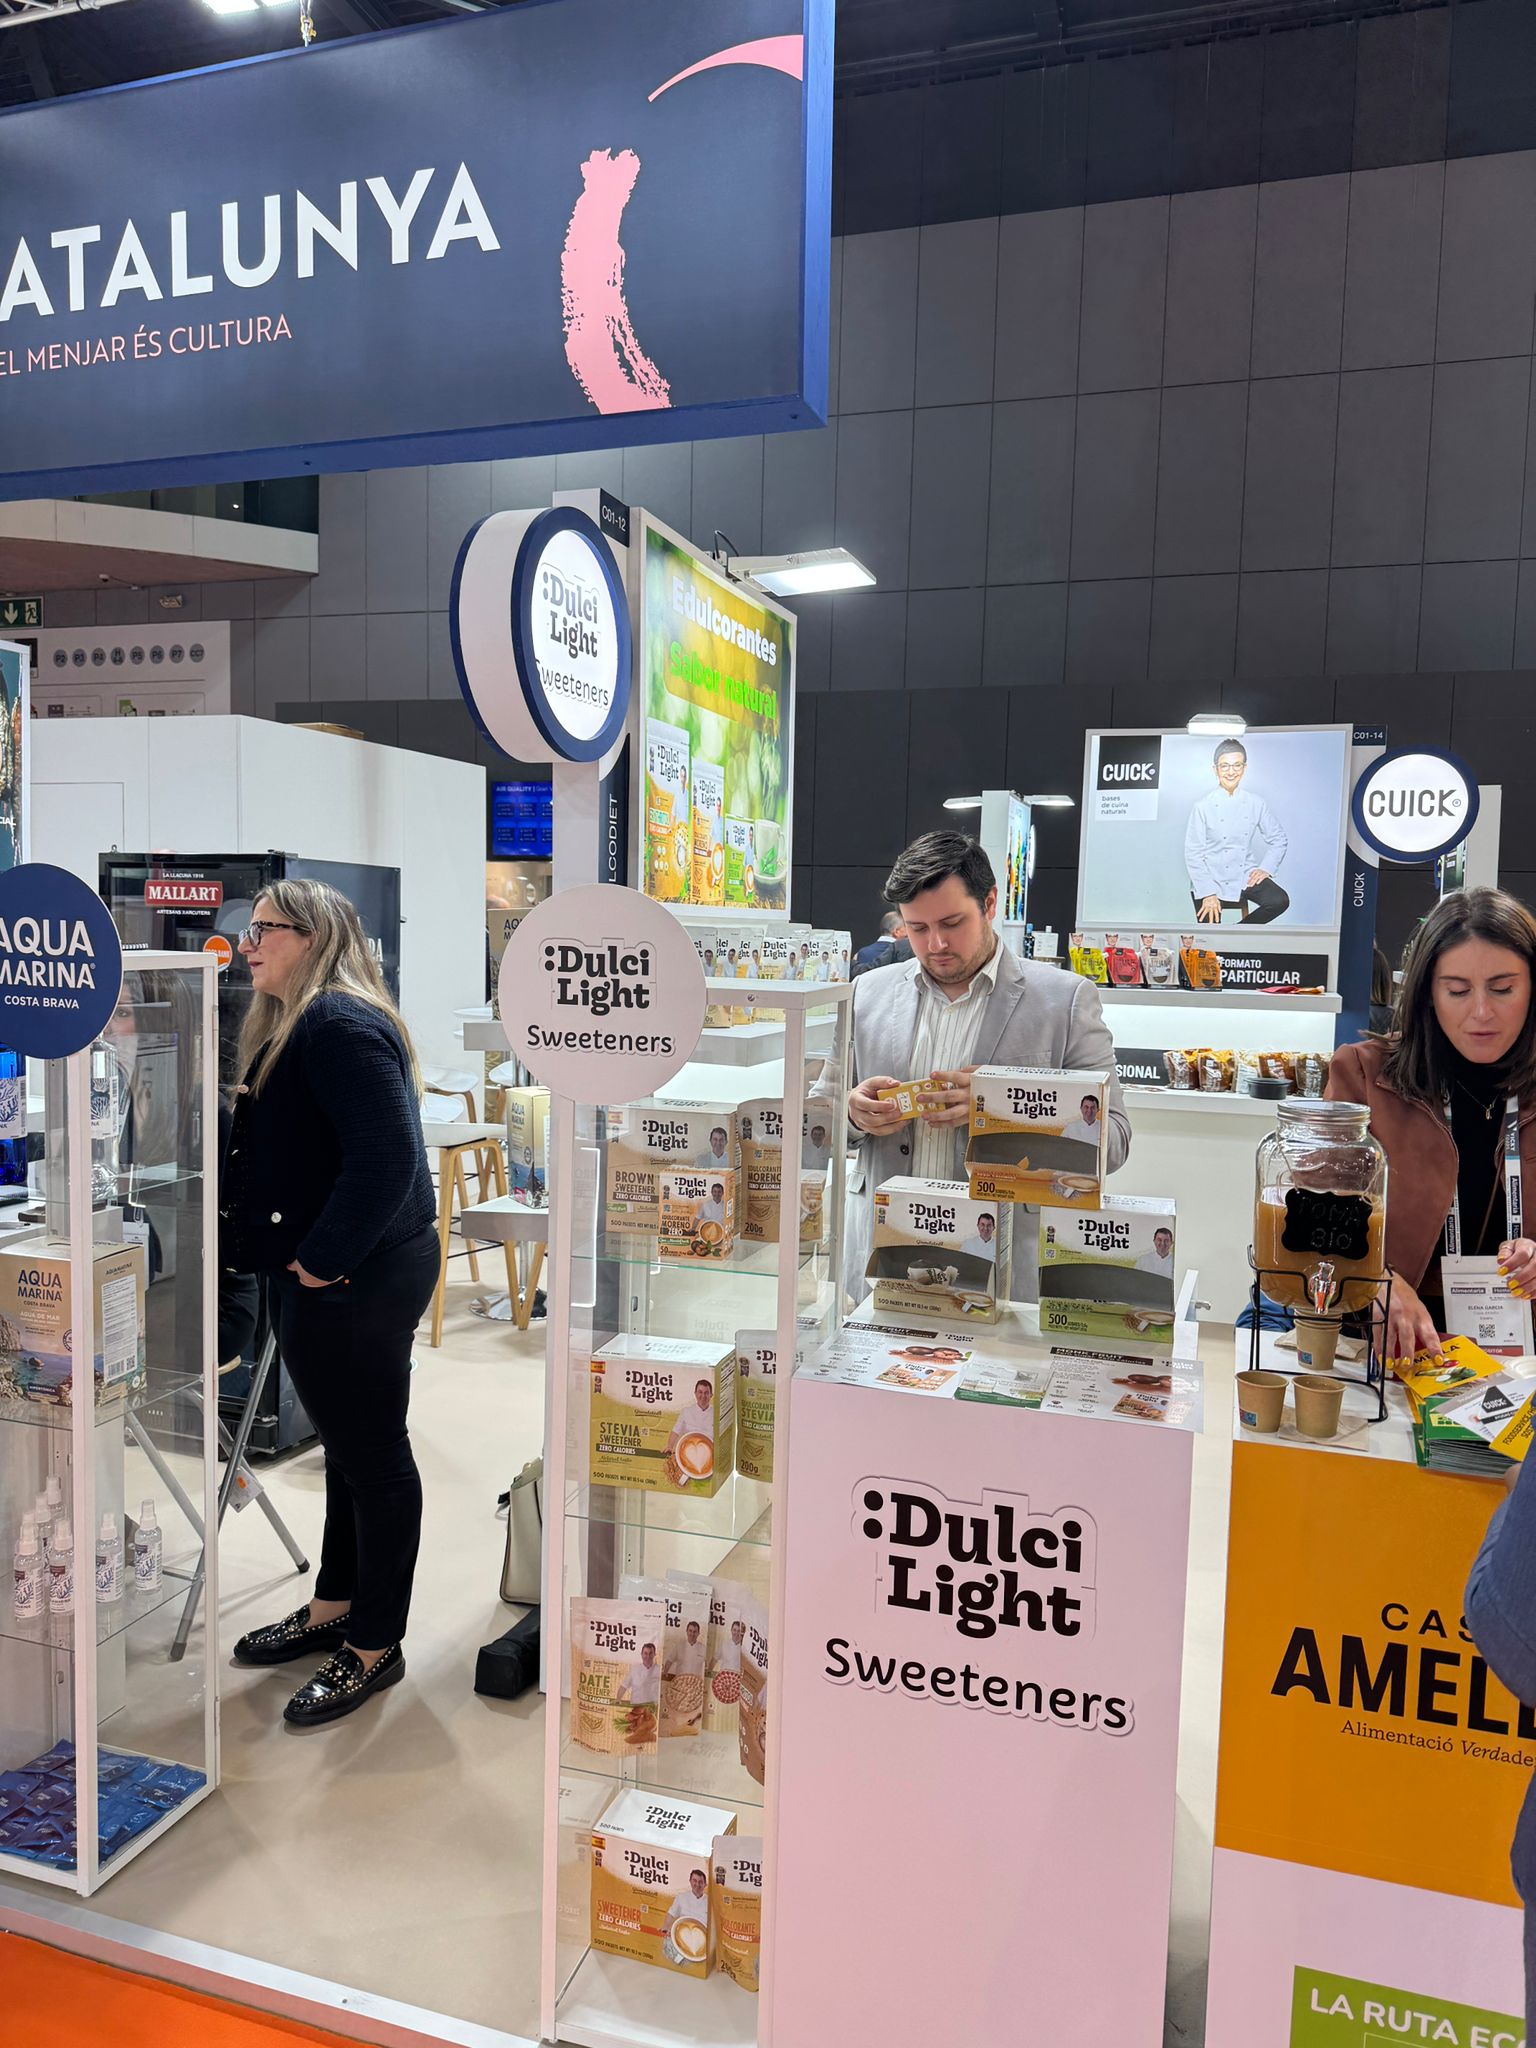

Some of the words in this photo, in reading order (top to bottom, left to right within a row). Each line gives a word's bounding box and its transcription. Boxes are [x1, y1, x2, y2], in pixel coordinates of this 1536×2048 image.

[0, 161, 501, 321] ATALUNYA
[28, 336, 125, 372] MENJAR
[134, 324, 162, 359] ÉS
[169, 313, 292, 355] CULTURA
[602, 505, 627, 533] C01-12
[672, 576, 778, 667] Edulcorantes
[550, 610, 599, 659] Light
[670, 641, 720, 693] Sabor
[724, 674, 777, 721] natural
[1353, 731, 1383, 740] C01-14
[659, 762, 680, 782] Light
[1102, 762, 1154, 782] CUICK
[507, 785, 532, 793] QUALITY
[700, 793, 716, 809] Light
[1368, 789, 1457, 818] CUICK
[608, 793, 618, 883] LCODIET
[148, 885, 219, 901] MALLART
[1354, 872, 1365, 907] CUICK
[763, 949, 787, 960] Light
[1220, 958, 1262, 969] FORMATO
[1220, 969, 1300, 985] PARTICULAR
[5, 995, 39, 1007] COSTA
[43, 997, 79, 1009] BRAVA
[557, 978, 650, 1016] Light
[527, 1024, 673, 1054] Sweeteners
[1012, 1102, 1057, 1119] Light
[647, 1134, 688, 1152] Light
[615, 1170, 654, 1185] BROWN
[615, 1183, 656, 1195] SWEETENER
[678, 1187, 707, 1198] Light
[977, 1181, 996, 1193] 500
[1511, 1177, 1519, 1214] Alimentaria
[615, 1192, 629, 1200] ZERO
[629, 1194, 652, 1202] CALORIES
[661, 1220, 691, 1230] MORENO
[668, 1228, 683, 1236] ZERO
[914, 1217, 955, 1235] Light
[1083, 1233, 1130, 1251] Light
[1447, 1215, 1455, 1253] Alimentaria
[660, 1245, 669, 1254] 50
[17, 1269, 63, 1289] AQUA
[17, 1286, 63, 1302] MARINA
[849, 1321, 878, 1331] MONK
[1048, 1313, 1068, 1325] 500
[631, 1385, 673, 1403] Light
[1483, 1398, 1504, 1410] CUICK
[741, 1408, 775, 1421] STEVIA
[599, 1421, 641, 1438] STEVIA
[599, 1434, 642, 1447] SWEETENER
[598, 1444, 613, 1452] ZERO
[613, 1445, 636, 1455] CALORIES
[593, 1471, 605, 1479] 500
[740, 1459, 759, 1474] 200g
[887, 1554, 1082, 1639] Light
[594, 1633, 636, 1652] Light
[579, 1671, 611, 1689] DATE
[824, 1637, 1127, 1730] Sweeteners
[1341, 1718, 1454, 1753] Alimentació
[644, 1814, 686, 1831] Light
[629, 1864, 669, 1885] Light
[597, 1900, 641, 1922] SWEETENER
[598, 1913, 614, 1923] ZERO
[614, 1916, 641, 1931] CALORIES
[594, 1937, 605, 1946] 500
[1310, 1987, 1354, 2021] LA
[1363, 2000, 1459, 2045] RUTA
